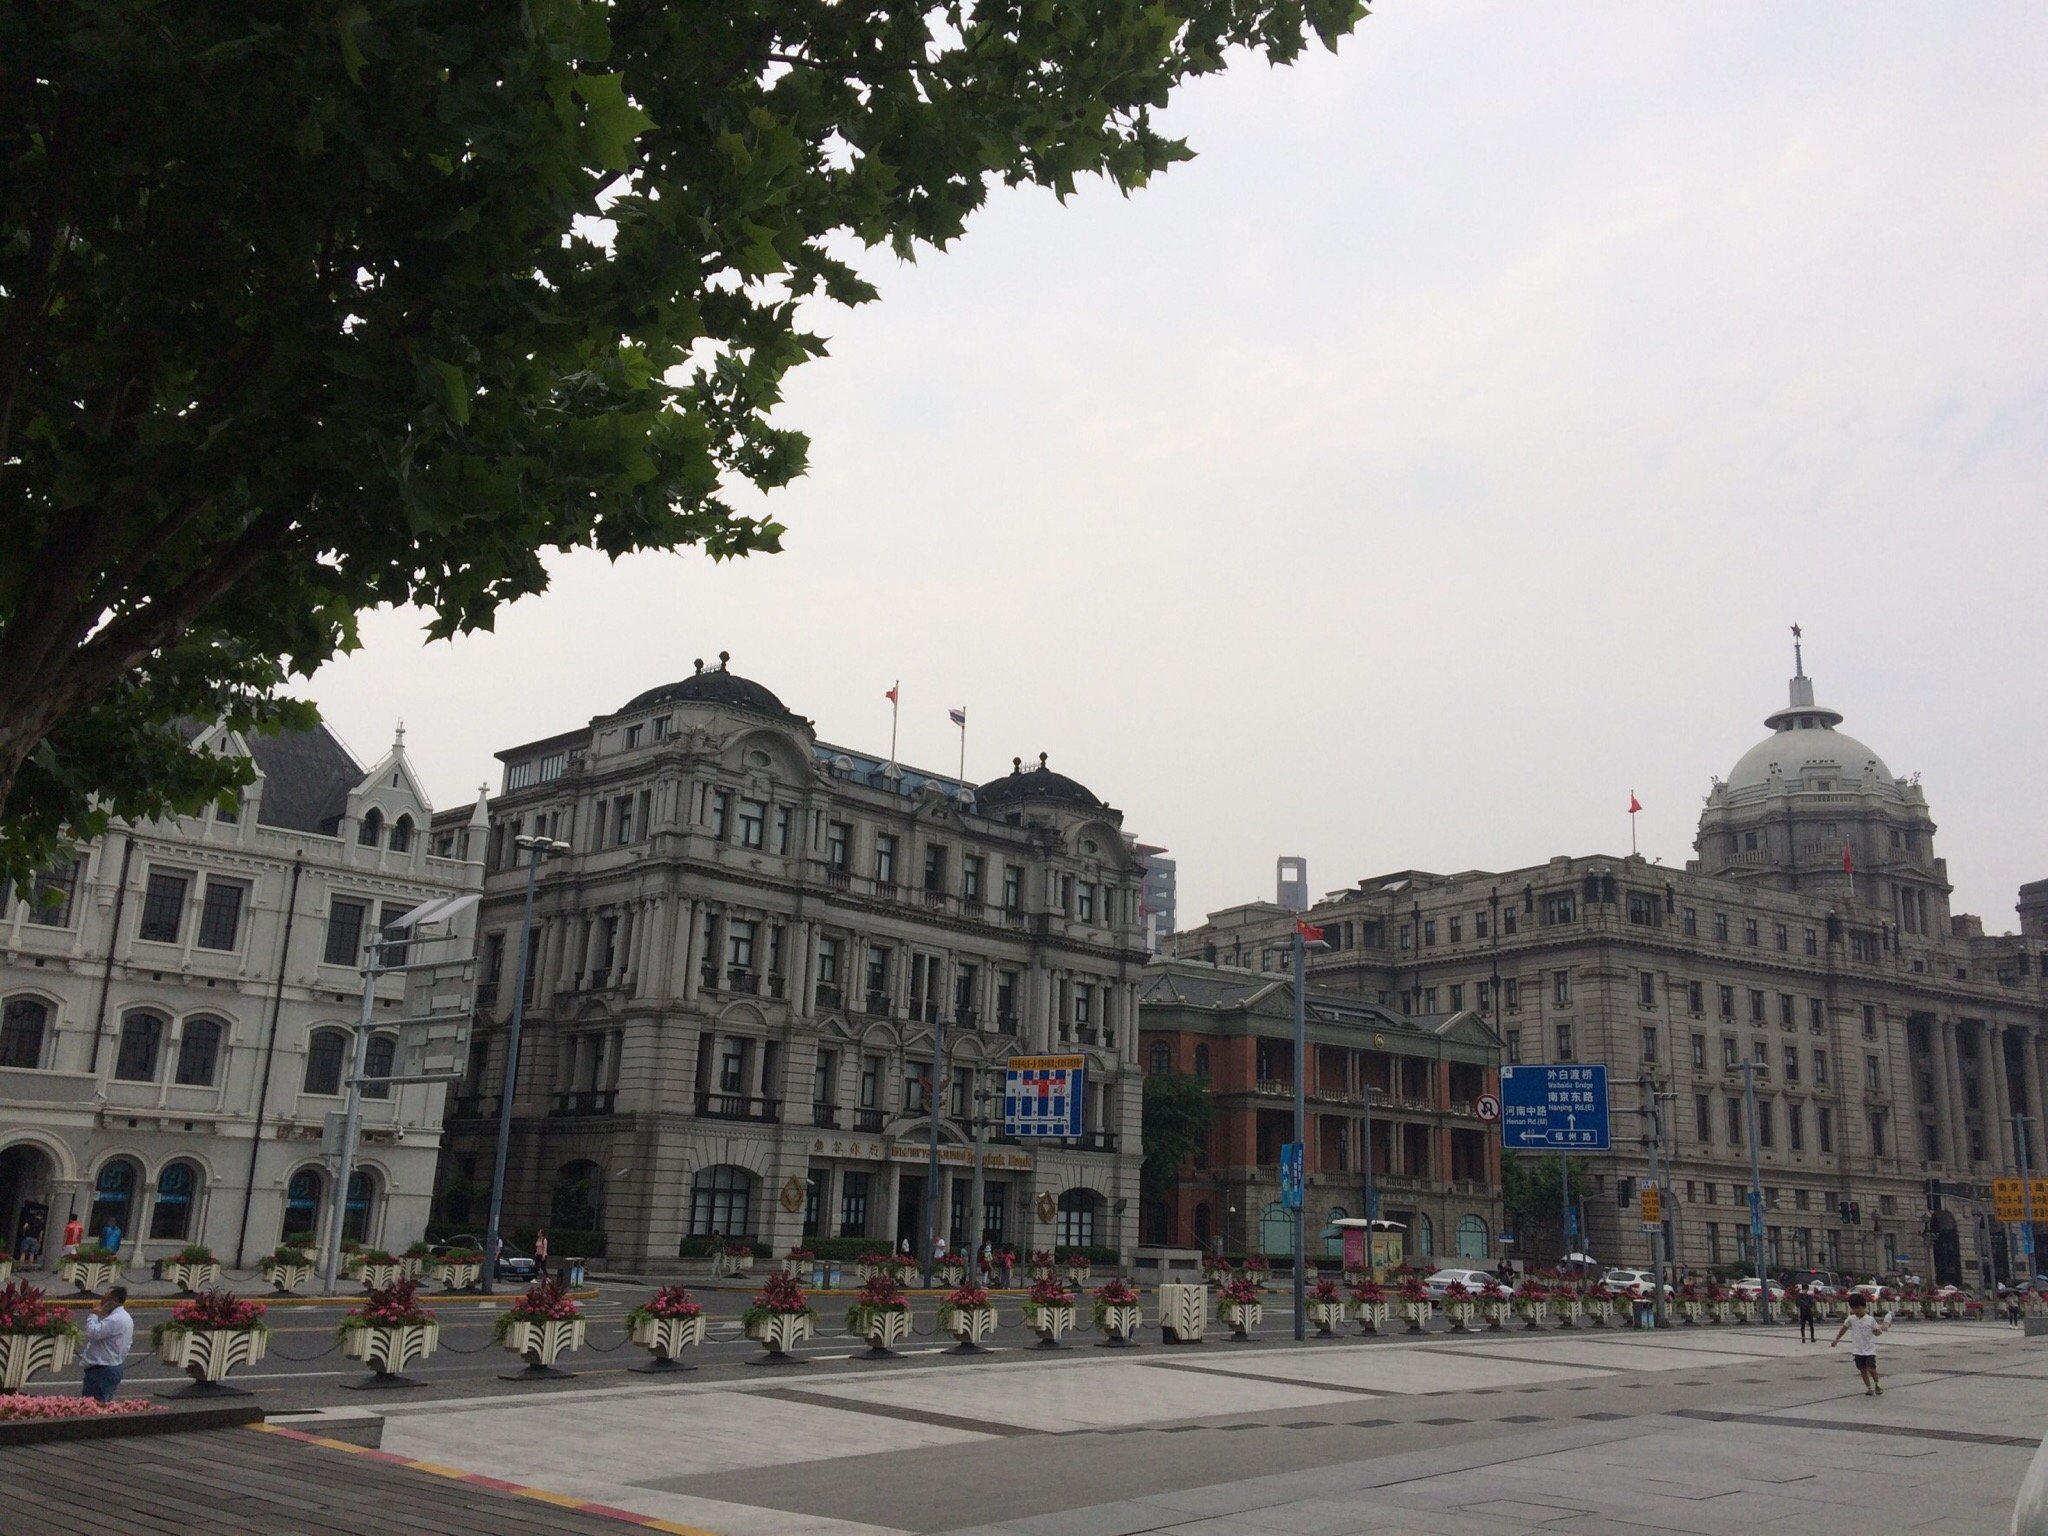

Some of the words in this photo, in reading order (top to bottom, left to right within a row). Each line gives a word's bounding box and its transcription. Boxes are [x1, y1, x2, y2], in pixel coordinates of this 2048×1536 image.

[1547, 1069, 1592, 1080] 外白渡桥
[1547, 1091, 1593, 1102] 南京东路
[1505, 1105, 1547, 1117] 河南中路
[1548, 1104, 1573, 1112] Nanjing
[1527, 1118, 1548, 1126] Rd.(M)
[1555, 1132, 1591, 1141] 福州路
